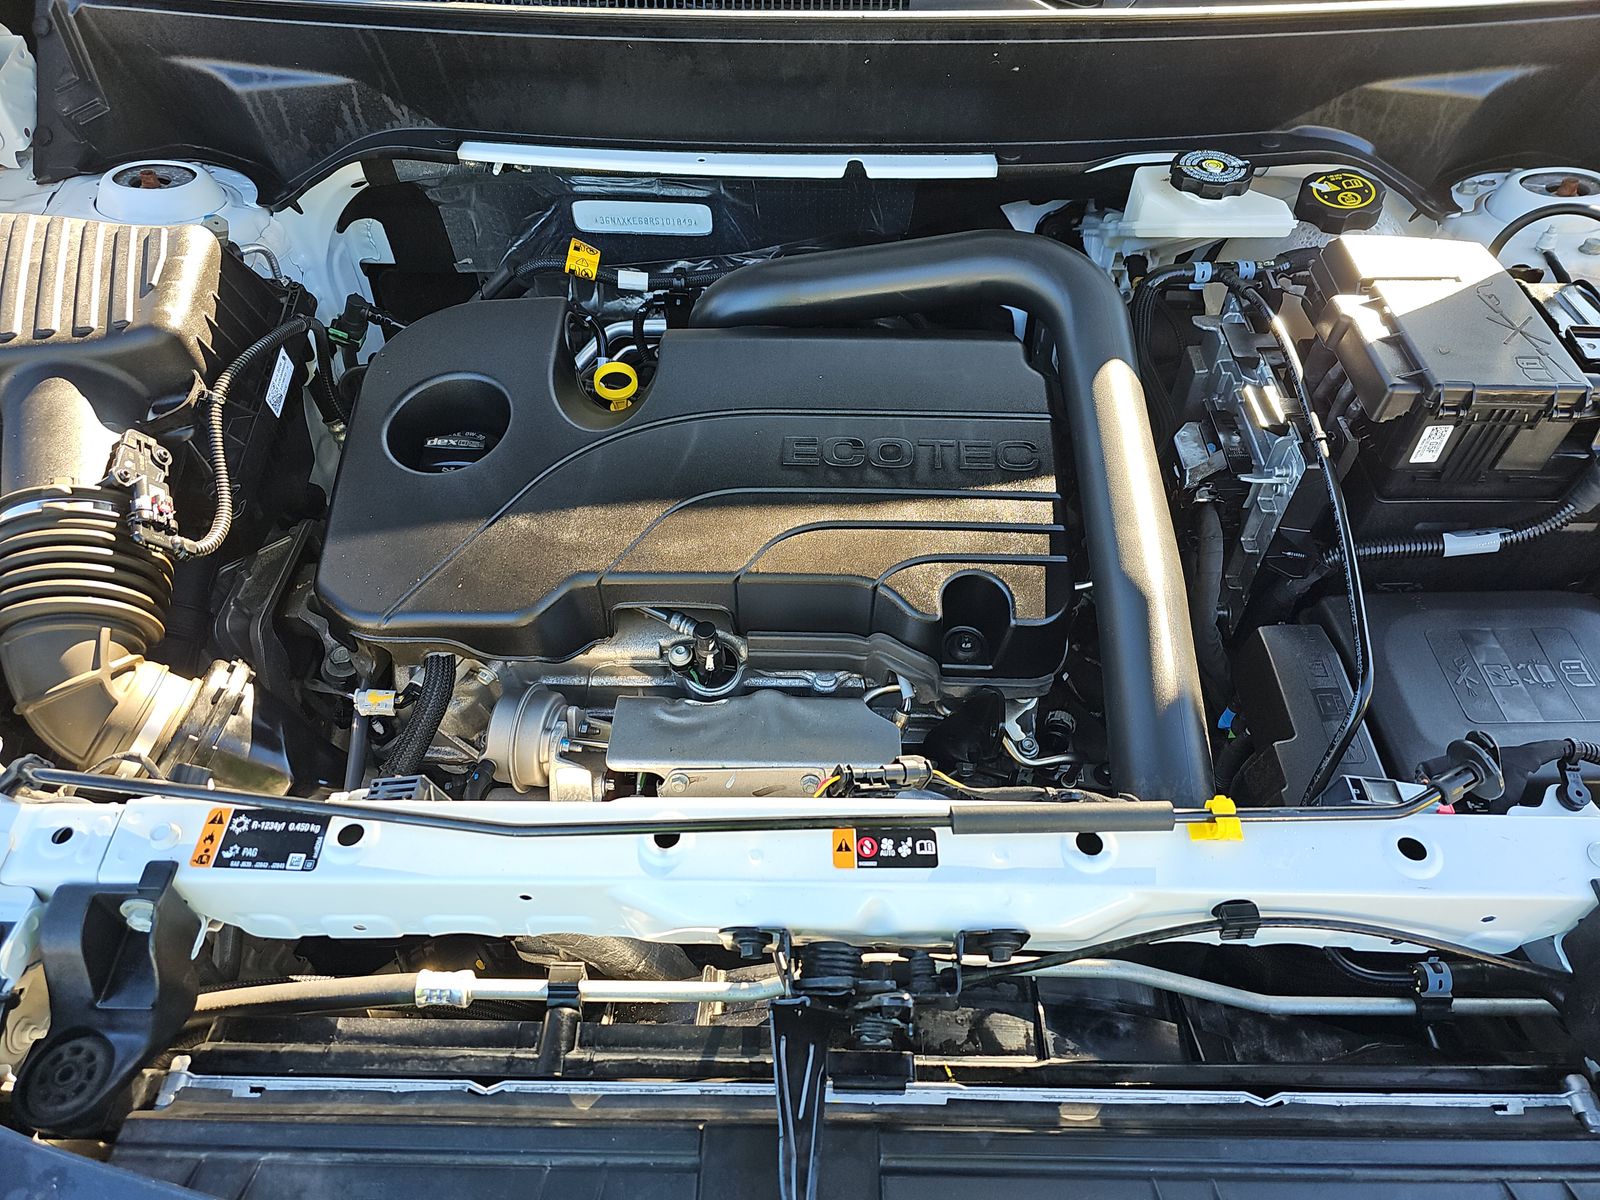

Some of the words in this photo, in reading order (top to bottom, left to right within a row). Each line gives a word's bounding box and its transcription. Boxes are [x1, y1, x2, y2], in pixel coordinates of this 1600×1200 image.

[783, 436, 1039, 471] ECOTEC
[288, 822, 310, 832] 0.450
[310, 823, 321, 834] kg
[242, 847, 258, 857] PAG
